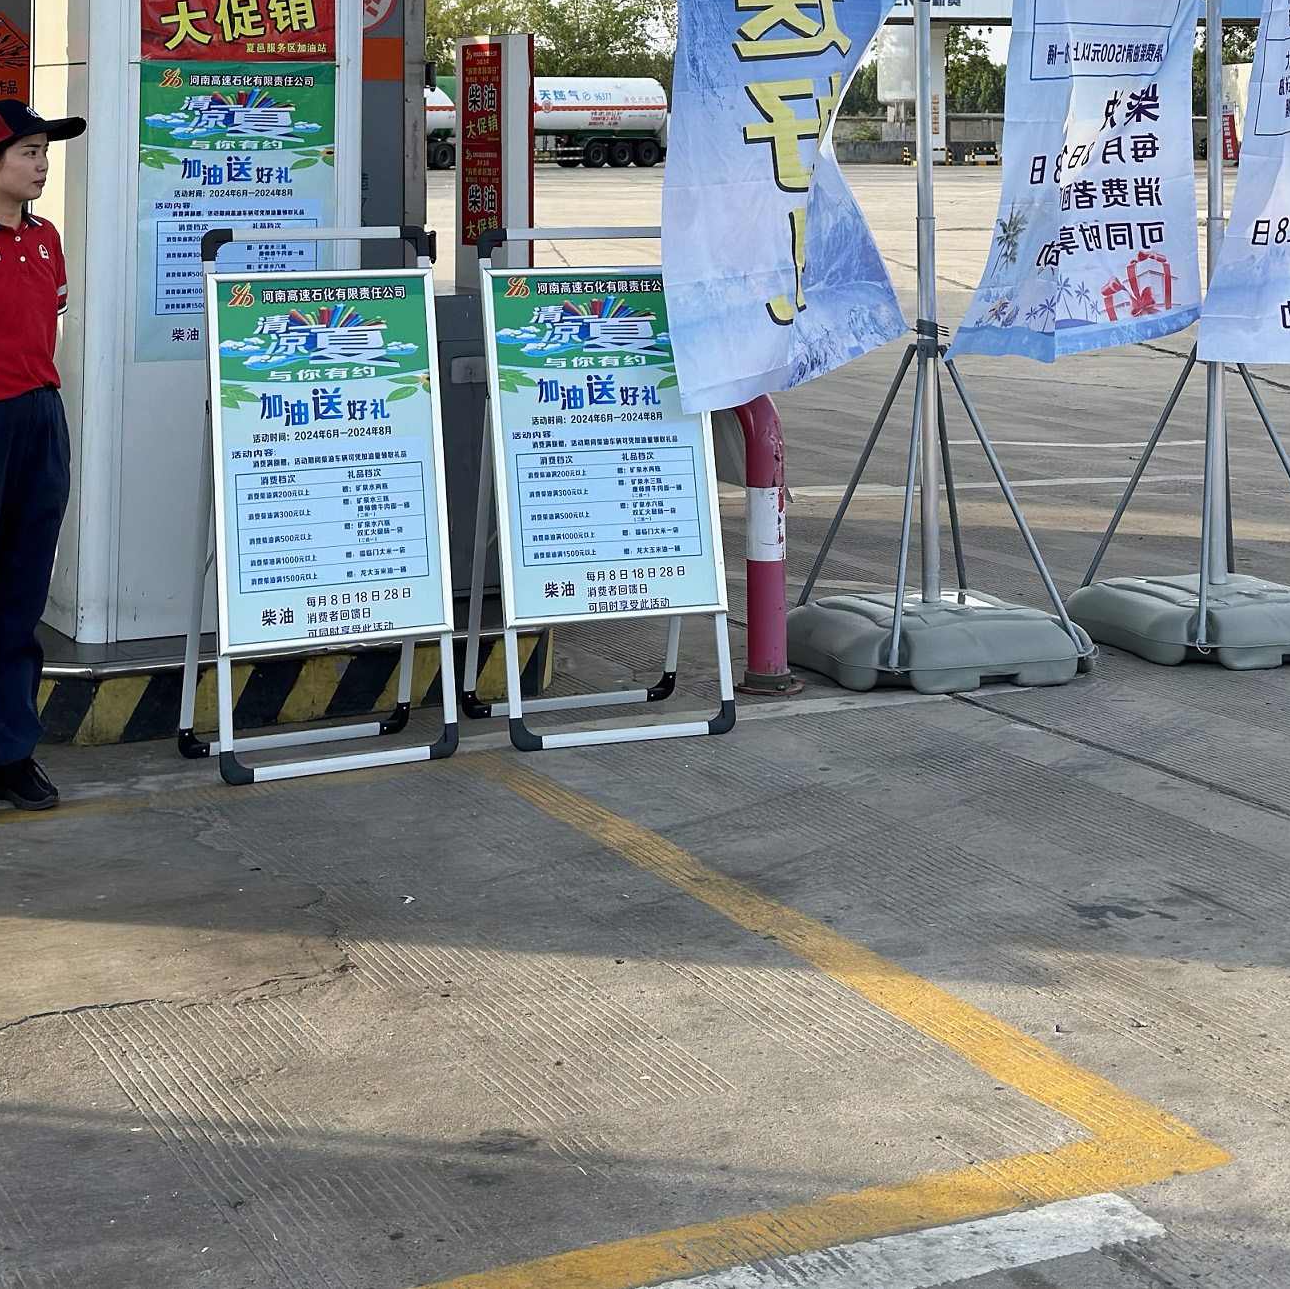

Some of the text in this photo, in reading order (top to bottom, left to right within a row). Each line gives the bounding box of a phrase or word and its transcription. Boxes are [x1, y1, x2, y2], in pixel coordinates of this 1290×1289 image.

[246, 41, 327, 54] 夏邑服务区加油站
[189, 74, 315, 88] 河南高速石化有限责任公司
[468, 84, 496, 112] 柴油
[466, 114, 498, 139] 大促销
[189, 139, 283, 150] 与你有约
[181, 155, 292, 186] 加油送好礼
[468, 184, 496, 213] 柴油
[262, 285, 406, 303] 河南高速石化有限责任公司
[537, 279, 662, 294] 河南高速石化有限责任公
[172, 327, 200, 342] 柴油
[543, 355, 647, 368] 与你有约
[267, 365, 376, 382] 与你有约
[538, 374, 661, 411] 加油送好礼
[259, 388, 391, 427] 加油送好礼
[260, 474, 296, 486] 消费档次
[347, 468, 382, 479] 礼品档次
[544, 581, 575, 598] 柴油
[587, 583, 648, 598] 消费者回馈日
[588, 597, 670, 612] 可同时享受此活动
[261, 607, 294, 627] 柴油
[307, 607, 371, 624] 消费者回馈日
